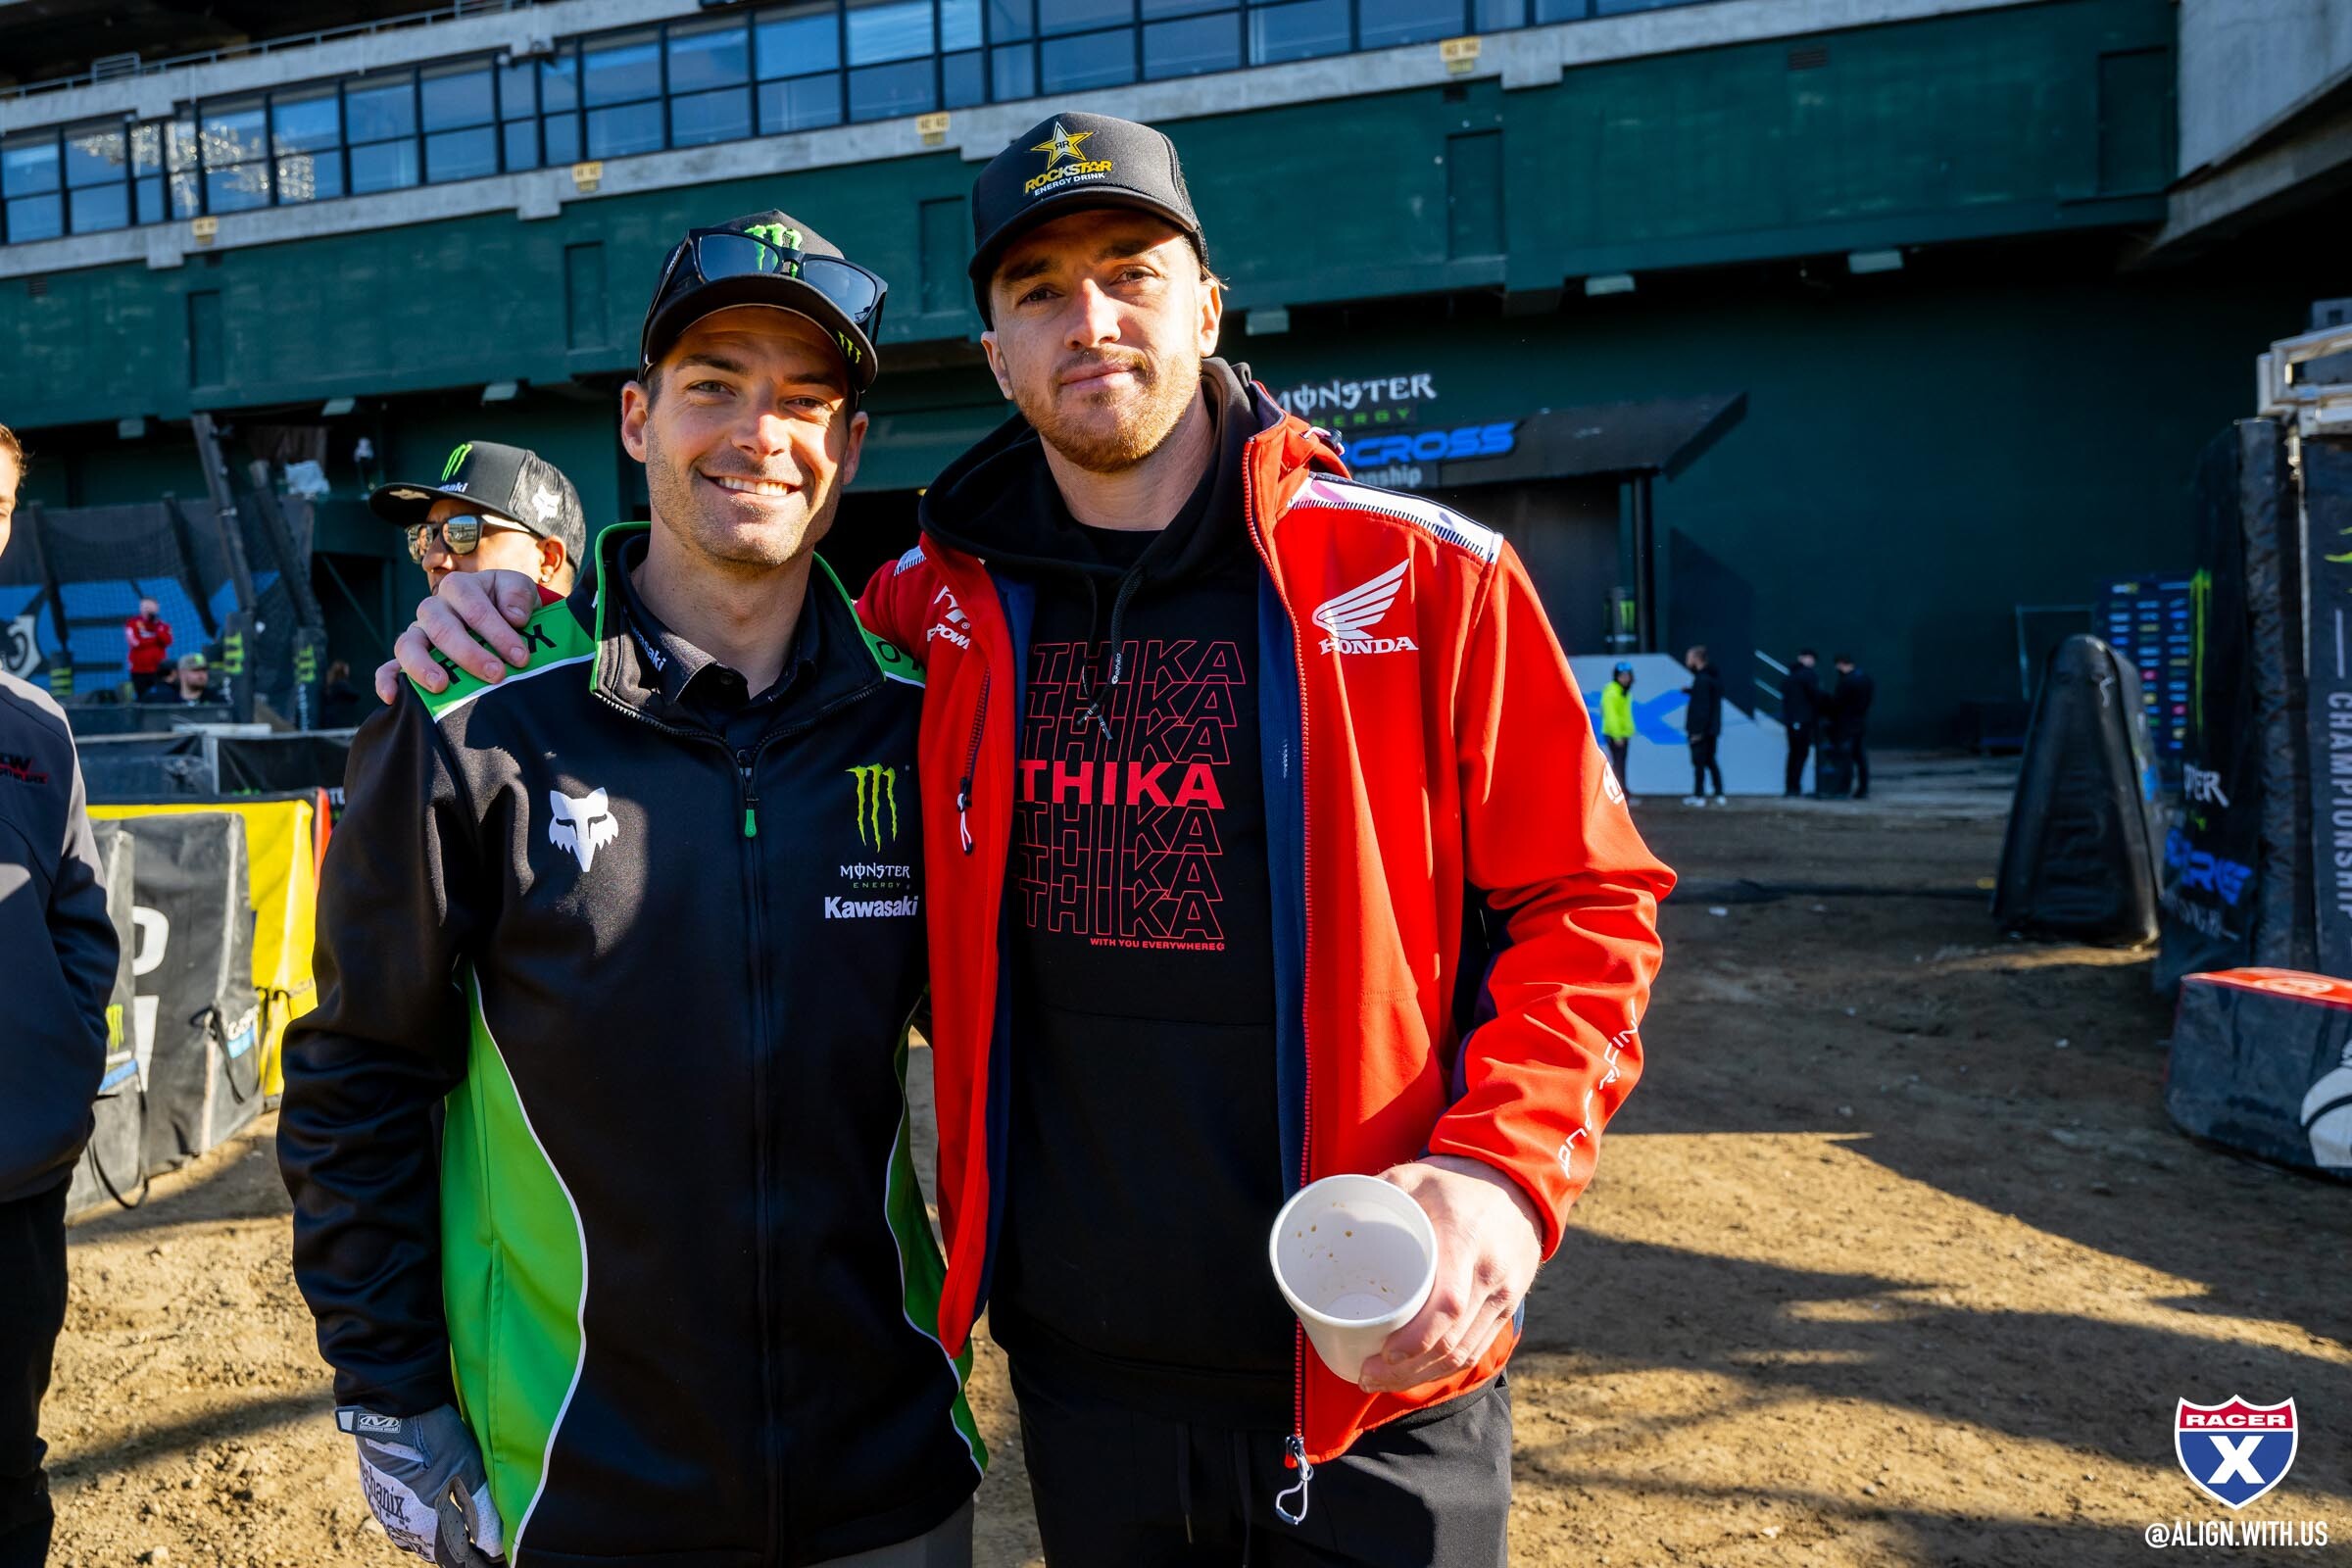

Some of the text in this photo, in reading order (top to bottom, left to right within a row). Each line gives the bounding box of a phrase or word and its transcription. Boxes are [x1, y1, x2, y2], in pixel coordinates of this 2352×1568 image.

[1024, 160, 1113, 194] ROCKSTAR
[1034, 172, 1106, 196] ENERGY DRINK
[1312, 408, 1411, 428] NERGY
[1343, 421, 1517, 468] CROSS
[1318, 636, 1419, 655] HONDA
[1017, 760, 1225, 809] THIKA
[840, 862, 910, 880] MONSTER
[824, 895, 919, 919] Kawasaki
[1090, 938, 1216, 952] WITH YOU EVERYWHERE
